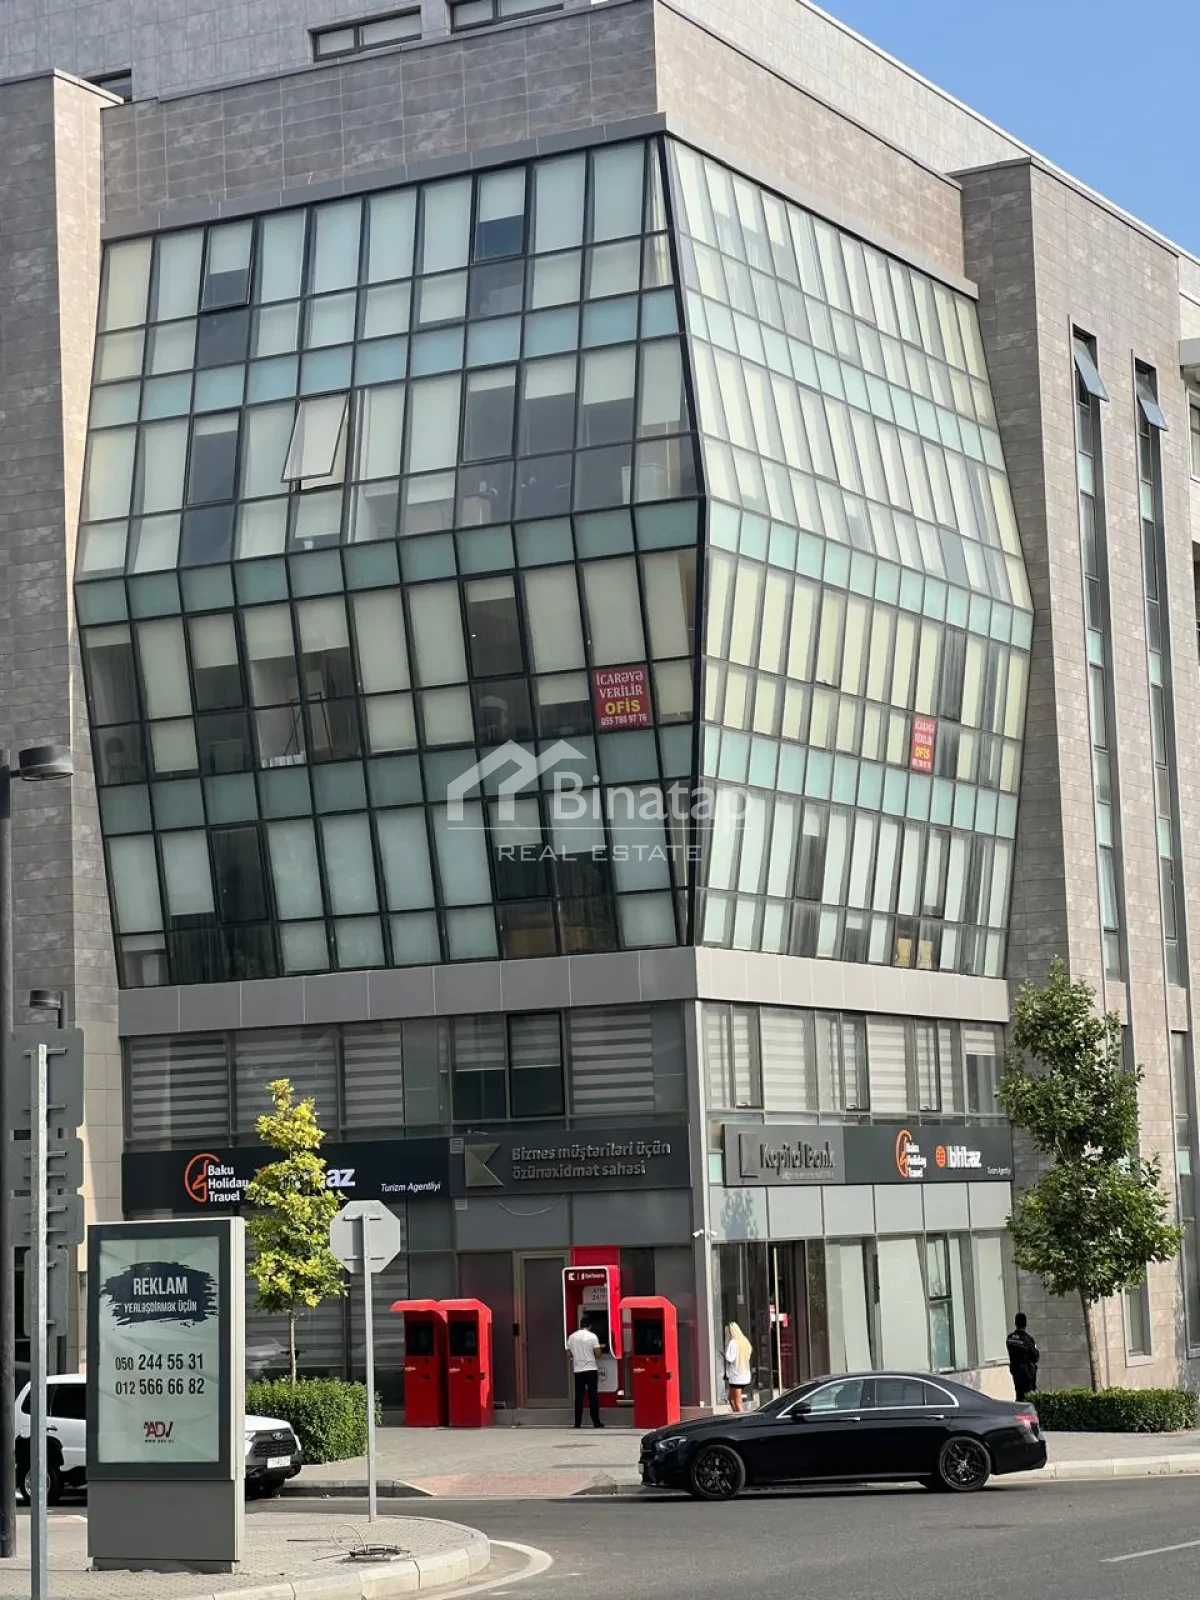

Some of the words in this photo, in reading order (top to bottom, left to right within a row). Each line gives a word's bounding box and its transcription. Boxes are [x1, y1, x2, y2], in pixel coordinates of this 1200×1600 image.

[600, 684, 642, 699] VERİLİR
[605, 698, 641, 715] OFİS
[512, 1146, 556, 1161] Biznes
[558, 1142, 634, 1161] müştəriləri
[636, 1140, 671, 1158] üçün
[207, 1165, 234, 1176] Baku
[512, 1163, 600, 1180] özünəxidmət
[602, 1160, 646, 1176] sahəsi
[207, 1178, 249, 1190] Holiday
[381, 1183, 406, 1192] Turizm
[209, 1190, 240, 1202] Travel
[133, 1276, 188, 1296] REKLAM
[123, 1301, 176, 1314] YERLƏŞDİRMƏK
[178, 1300, 197, 1314] ÜÇÜN
[115, 1357, 134, 1370] 050
[138, 1354, 163, 1370] 244
[167, 1354, 184, 1370] 55
[188, 1353, 203, 1370] 31
[115, 1381, 136, 1395] 012
[139, 1379, 163, 1395] 566
[168, 1379, 184, 1395] 66
[188, 1378, 205, 1395] 82
